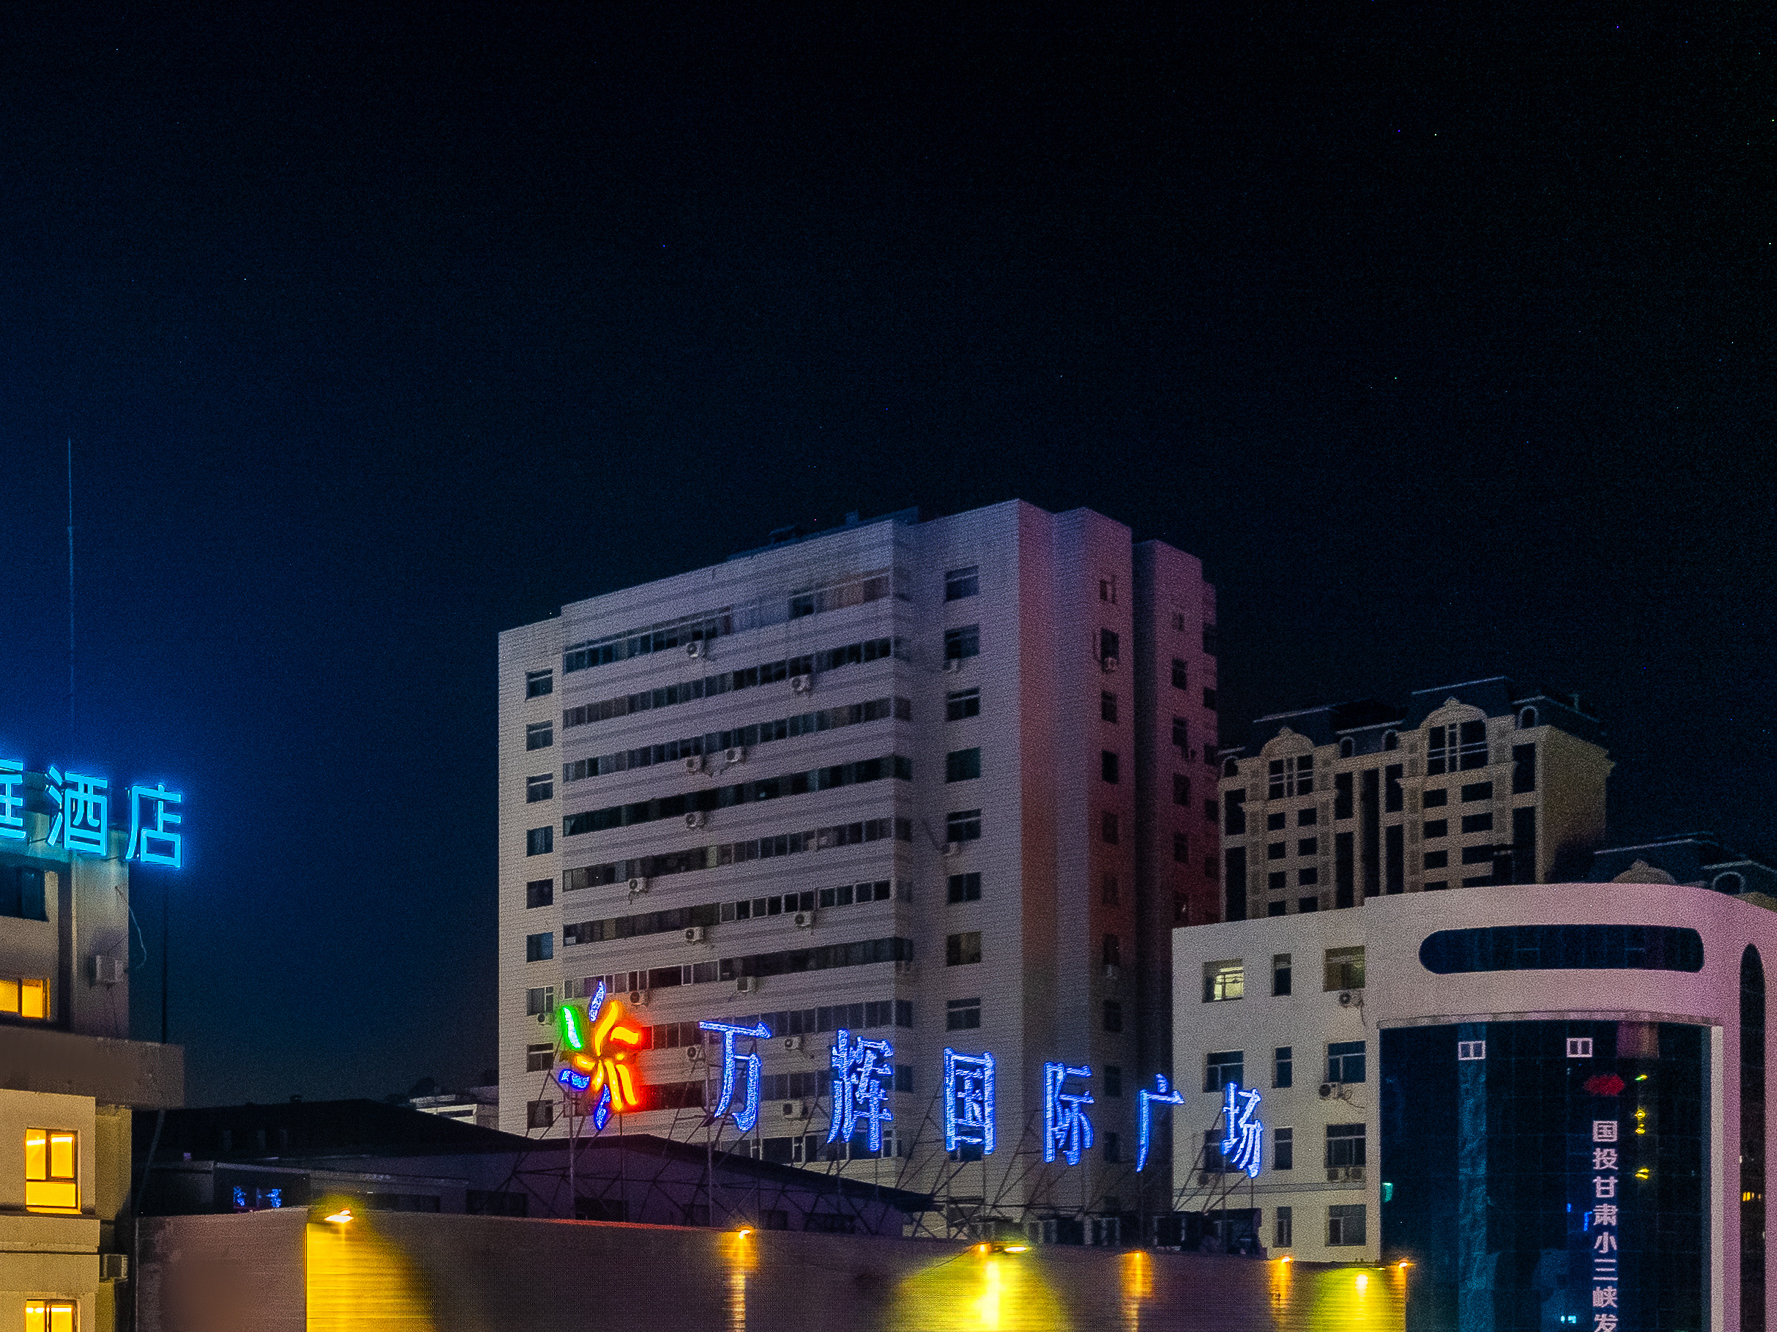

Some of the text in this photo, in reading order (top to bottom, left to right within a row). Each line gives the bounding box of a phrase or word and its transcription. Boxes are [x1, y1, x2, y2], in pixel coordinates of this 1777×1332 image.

[698, 1020, 1264, 1178] 万辉国际广场
